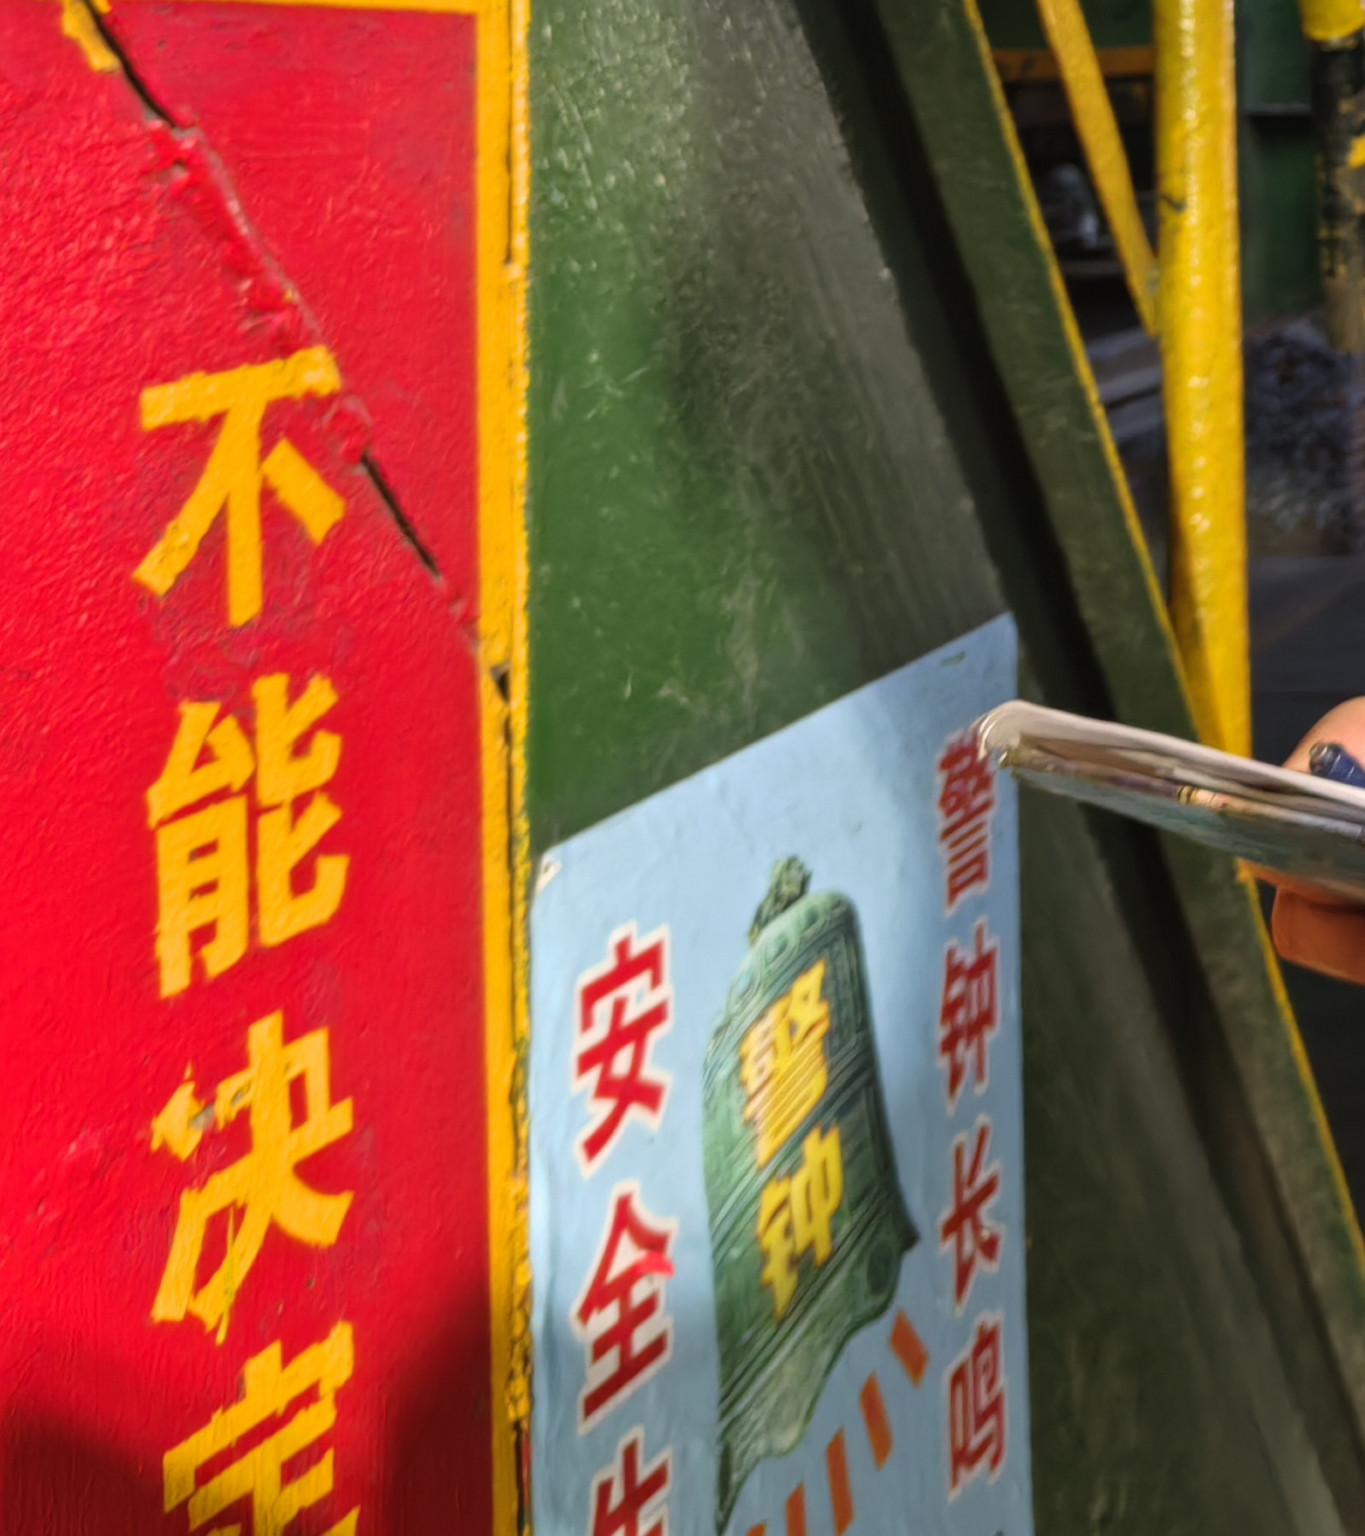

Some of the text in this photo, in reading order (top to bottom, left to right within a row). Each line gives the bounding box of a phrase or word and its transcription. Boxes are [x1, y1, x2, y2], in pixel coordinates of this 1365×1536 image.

[133, 344, 361, 1536] 不能决定
[738, 958, 843, 1322] 警钟
[936, 728, 1008, 1500] 警钟长鸣
